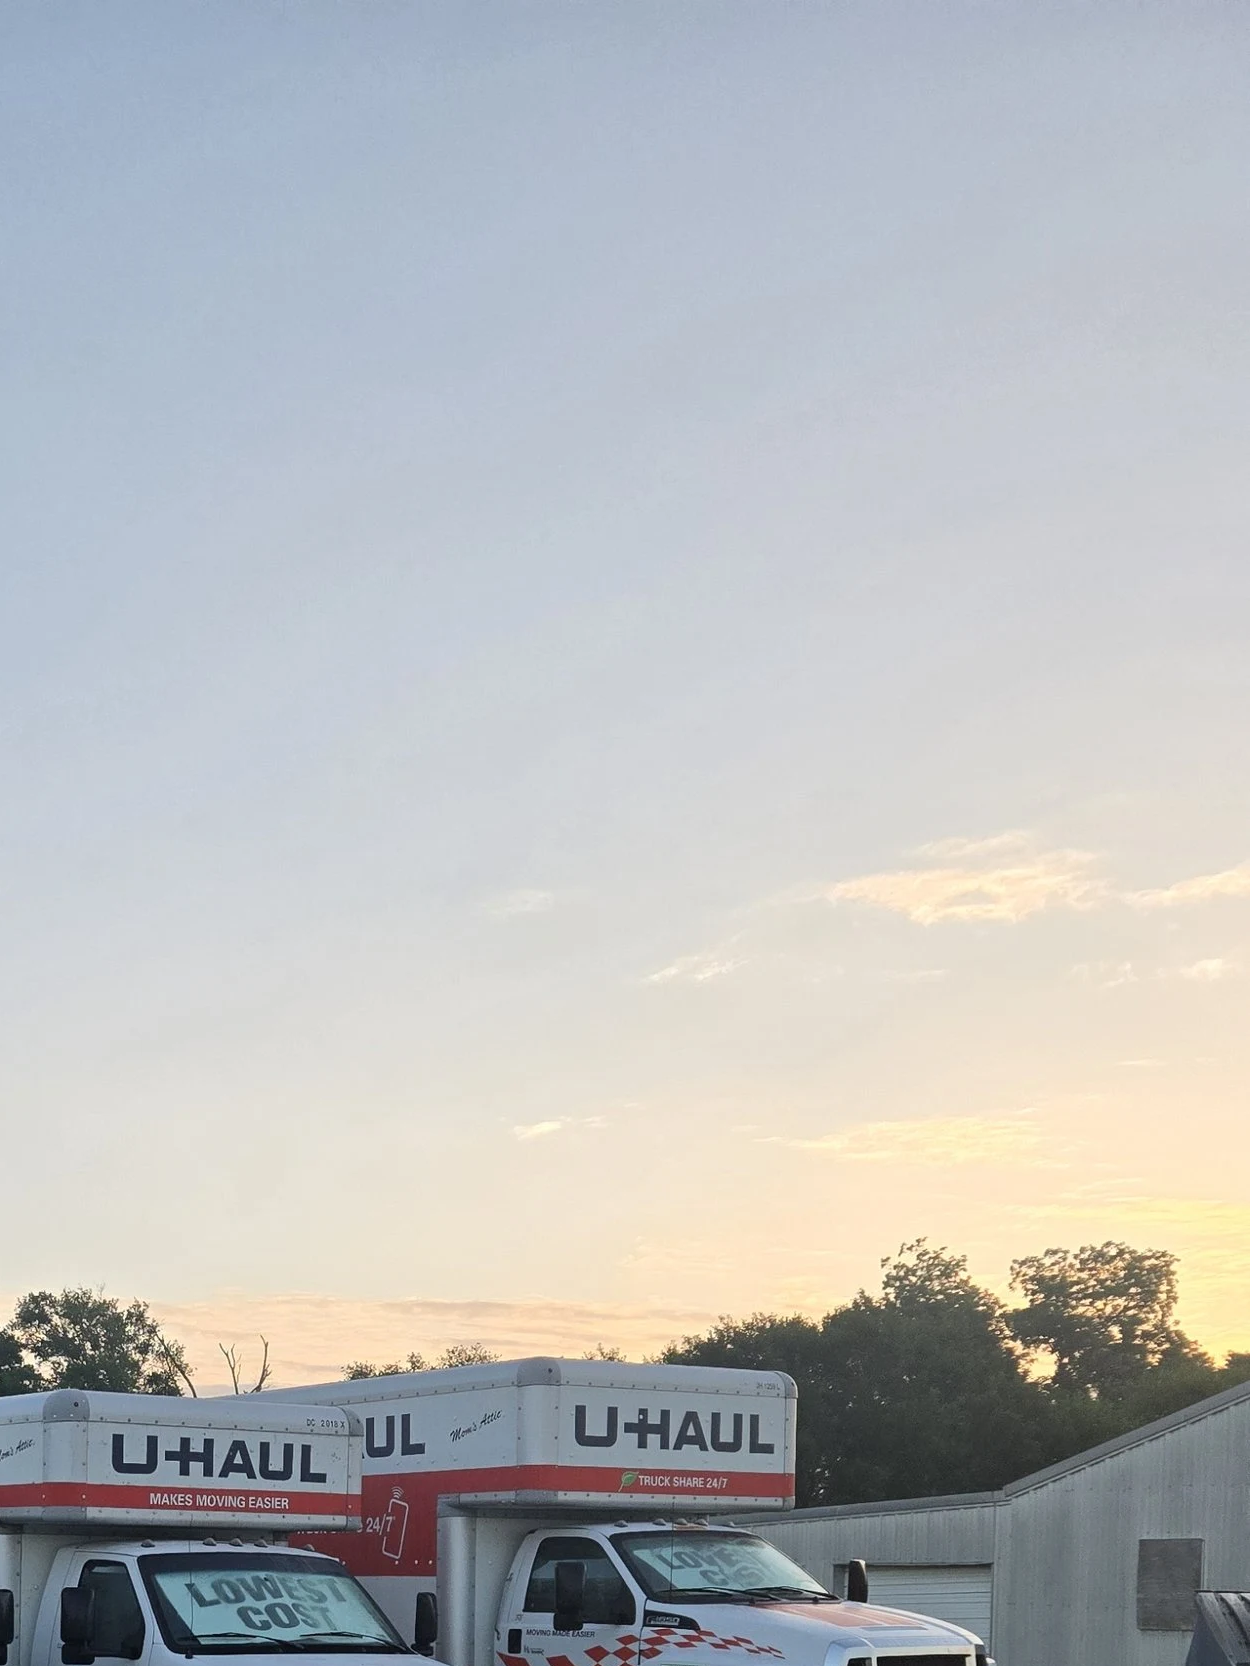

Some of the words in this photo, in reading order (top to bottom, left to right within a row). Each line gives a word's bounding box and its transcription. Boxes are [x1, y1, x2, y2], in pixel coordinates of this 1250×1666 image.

[340, 1420, 345, 1428] X
[574, 1404, 775, 1455] U-HAUL
[111, 1433, 328, 1484] U-HAUL
[638, 1475, 670, 1487] TRUCK
[672, 1476, 704, 1488] SHARE
[706, 1476, 728, 1489] 24/7
[150, 1492, 193, 1506] MAKES
[196, 1494, 246, 1508] MOVING
[248, 1496, 289, 1509] EASIER
[366, 1513, 393, 1535] 24/7
[185, 1573, 347, 1608] LOWEST
[236, 1602, 338, 1631] COST
[526, 1628, 550, 1636] MOVING
[571, 1630, 596, 1638] EASIER
